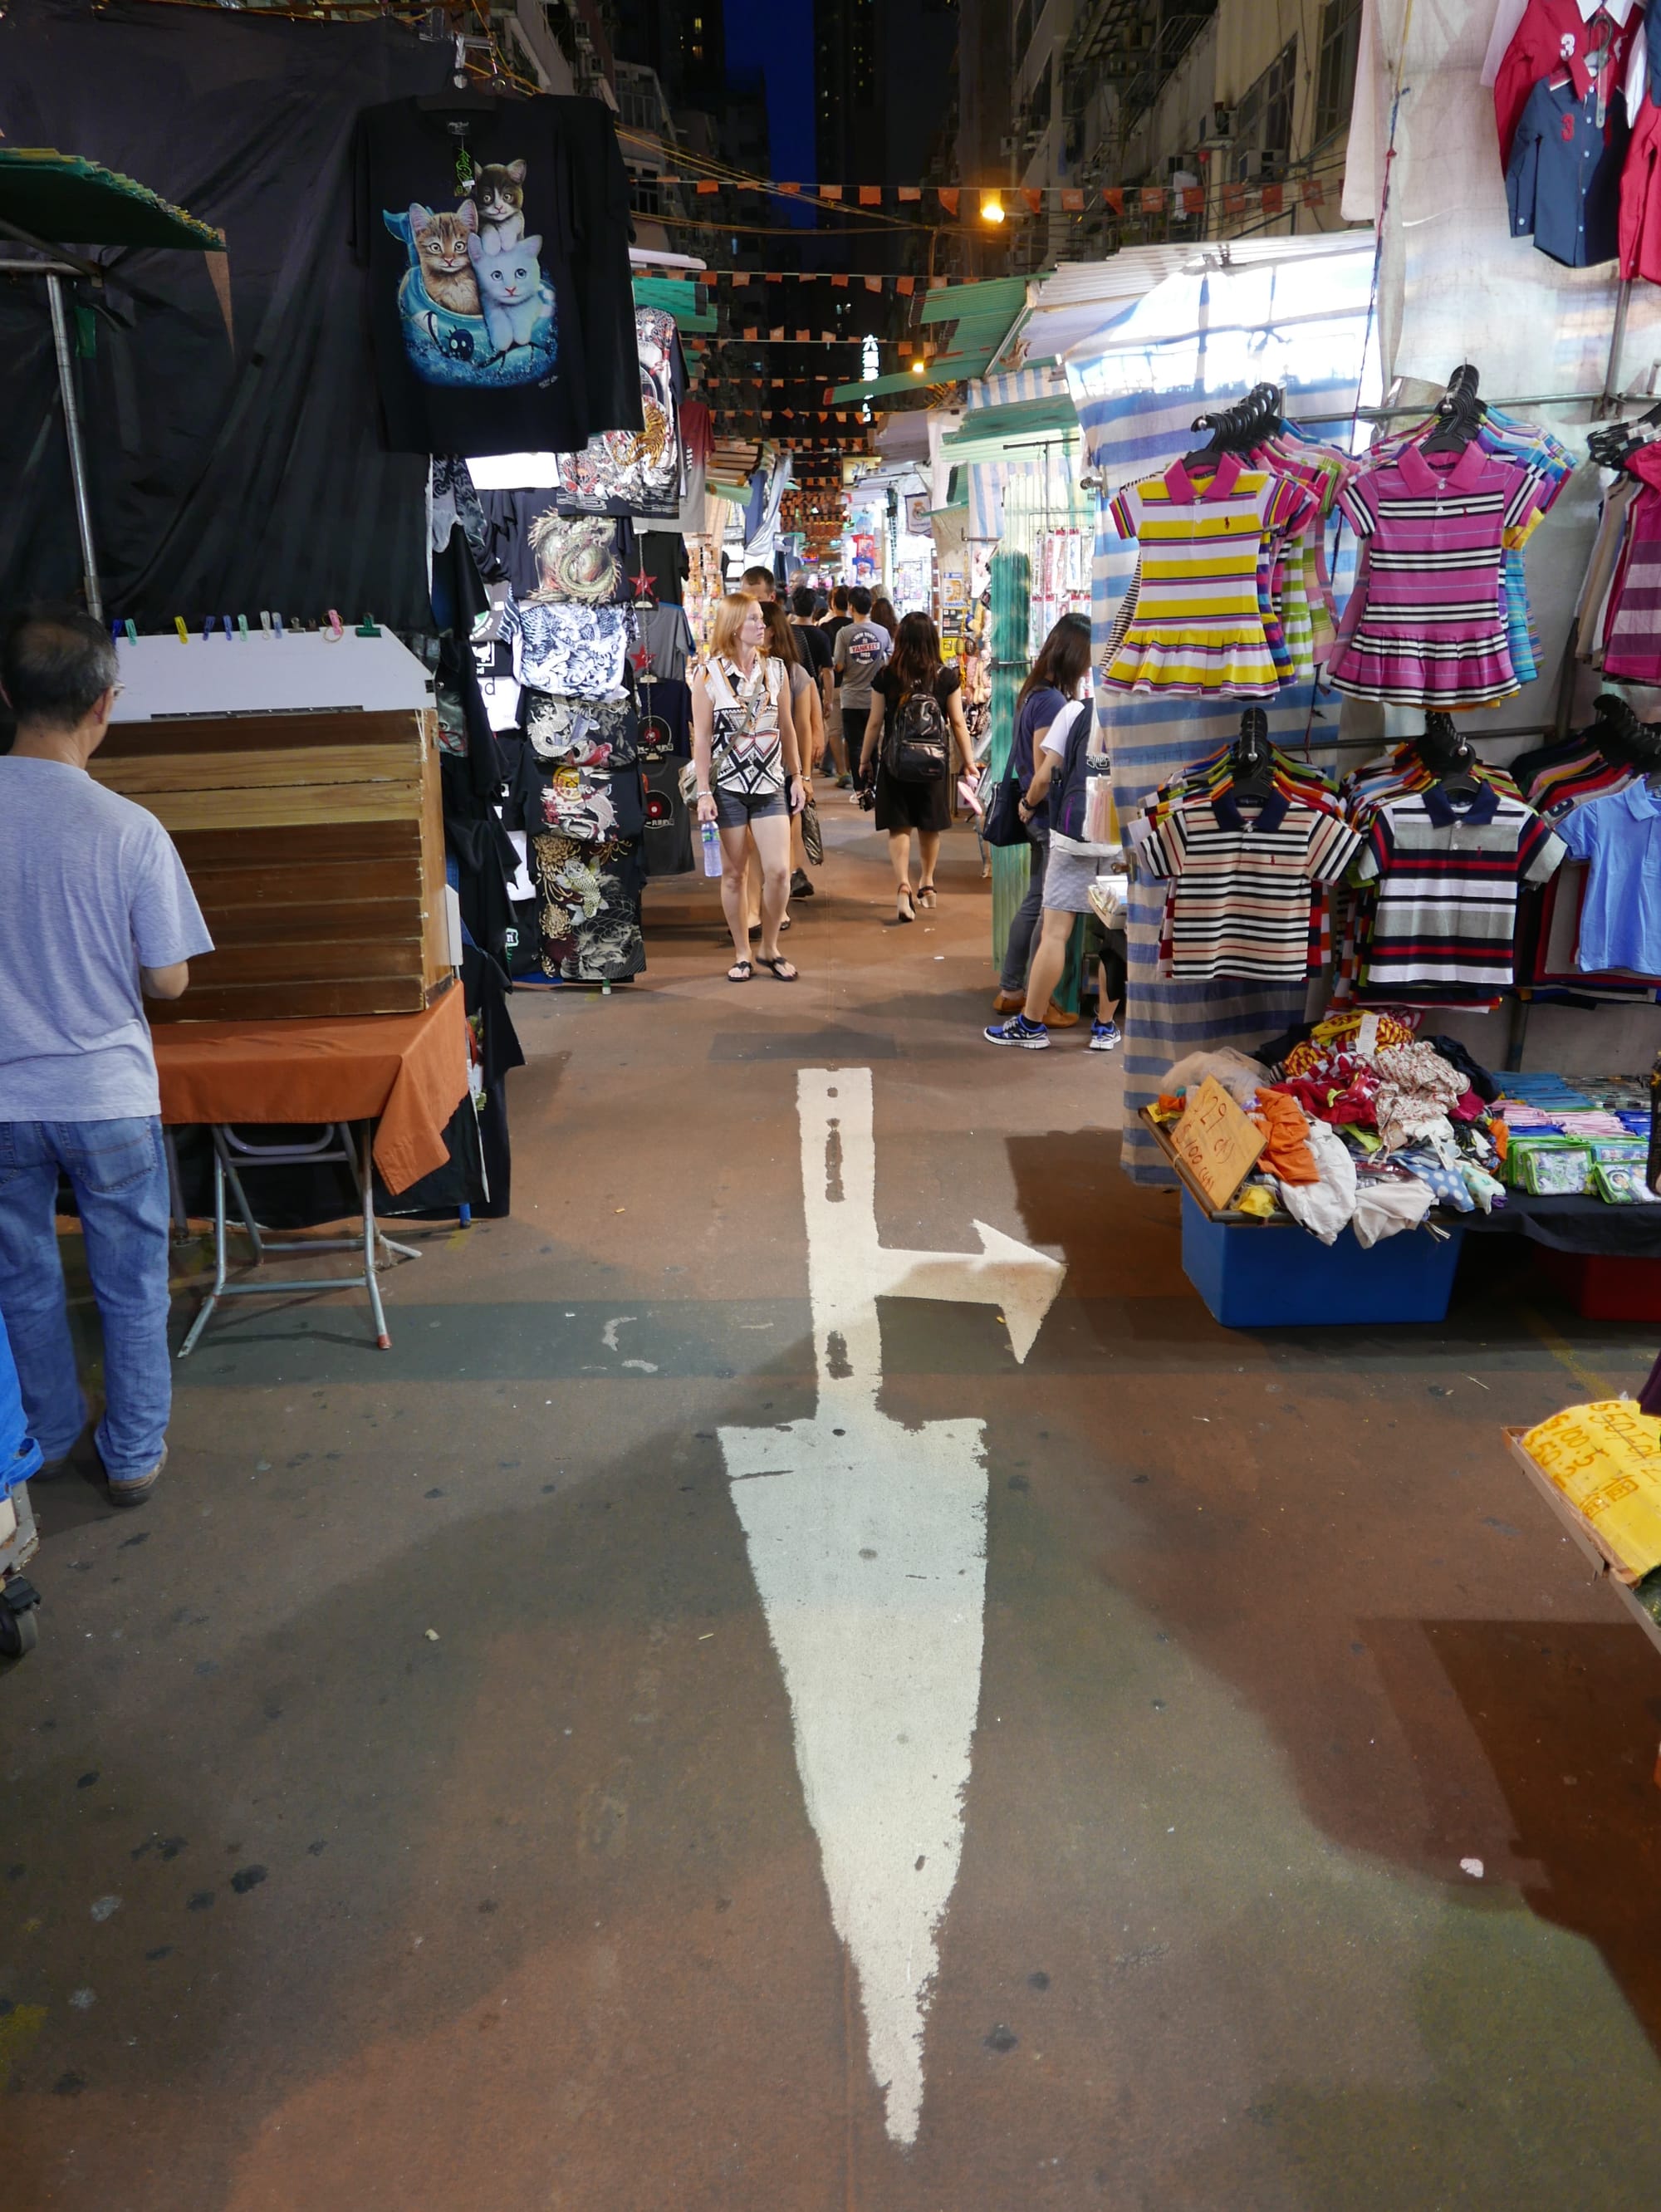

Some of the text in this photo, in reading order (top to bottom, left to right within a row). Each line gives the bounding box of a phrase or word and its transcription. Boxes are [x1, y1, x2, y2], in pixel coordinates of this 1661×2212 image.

[1560, 32, 1575, 61] 3
[1561, 113, 1575, 142] 3
[851, 643, 879, 652] YANKEES
